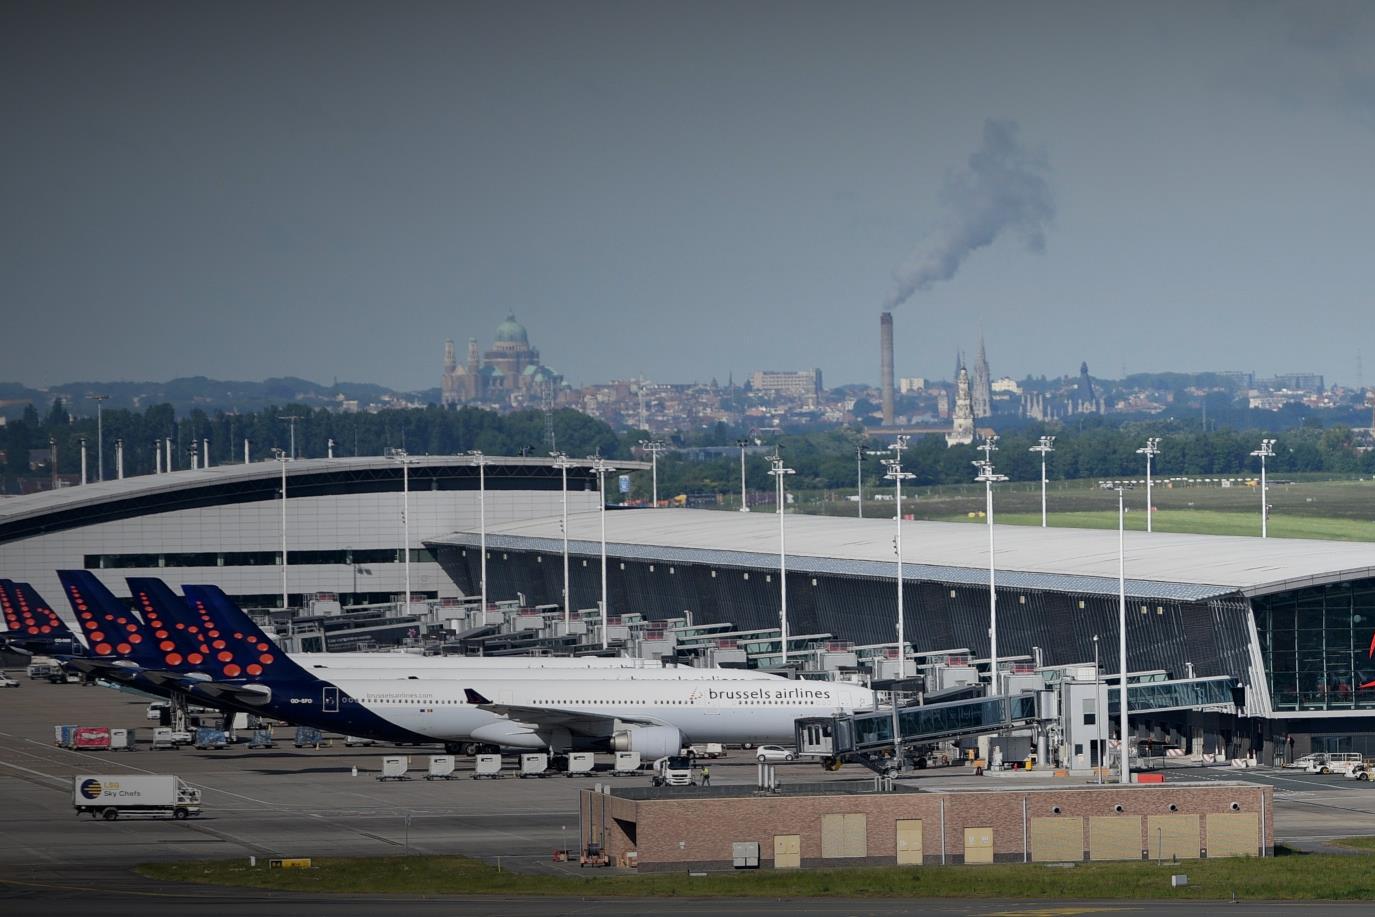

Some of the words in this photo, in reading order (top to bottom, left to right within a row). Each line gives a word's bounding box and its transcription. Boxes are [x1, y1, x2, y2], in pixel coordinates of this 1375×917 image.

[709, 688, 771, 700] brussels
[775, 688, 831, 699] airlines
[103, 790, 117, 799] Sky
[119, 790, 141, 798] Chefs
